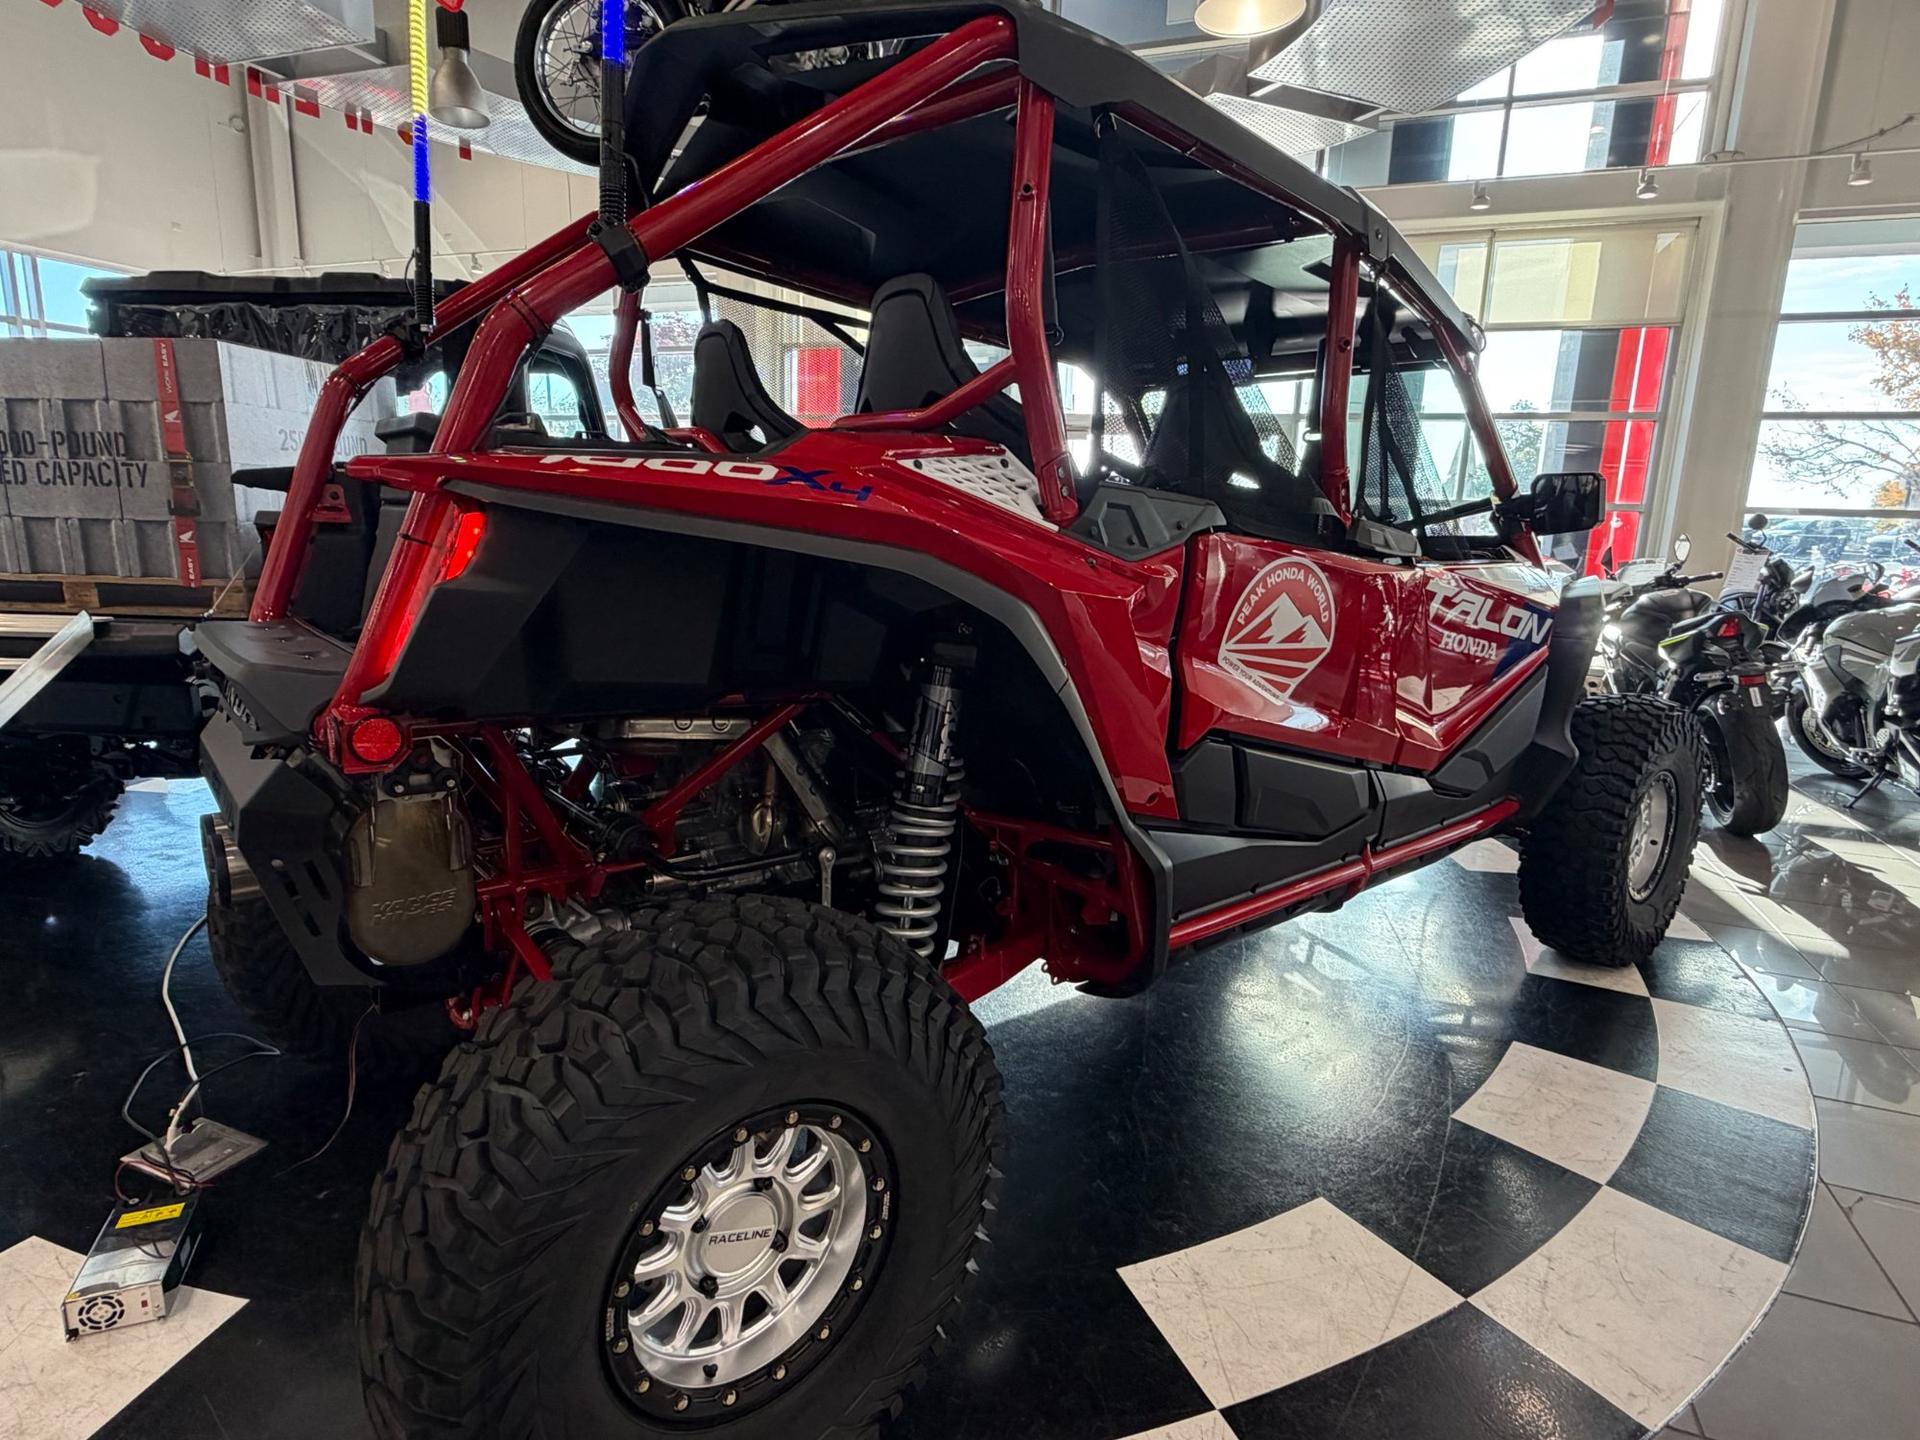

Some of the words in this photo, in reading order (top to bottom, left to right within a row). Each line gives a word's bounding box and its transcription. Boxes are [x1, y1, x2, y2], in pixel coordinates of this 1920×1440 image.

[36, 460, 148, 488] CAPACITY
[1237, 584, 1266, 625] PEAK
[1266, 567, 1304, 588] HONDA
[1307, 574, 1329, 623] WORLD
[1425, 577, 1554, 644] TALON
[1439, 631, 1498, 659] HONDA
[1222, 656, 1240, 672] POWER
[708, 1228, 772, 1246] RACELINE
